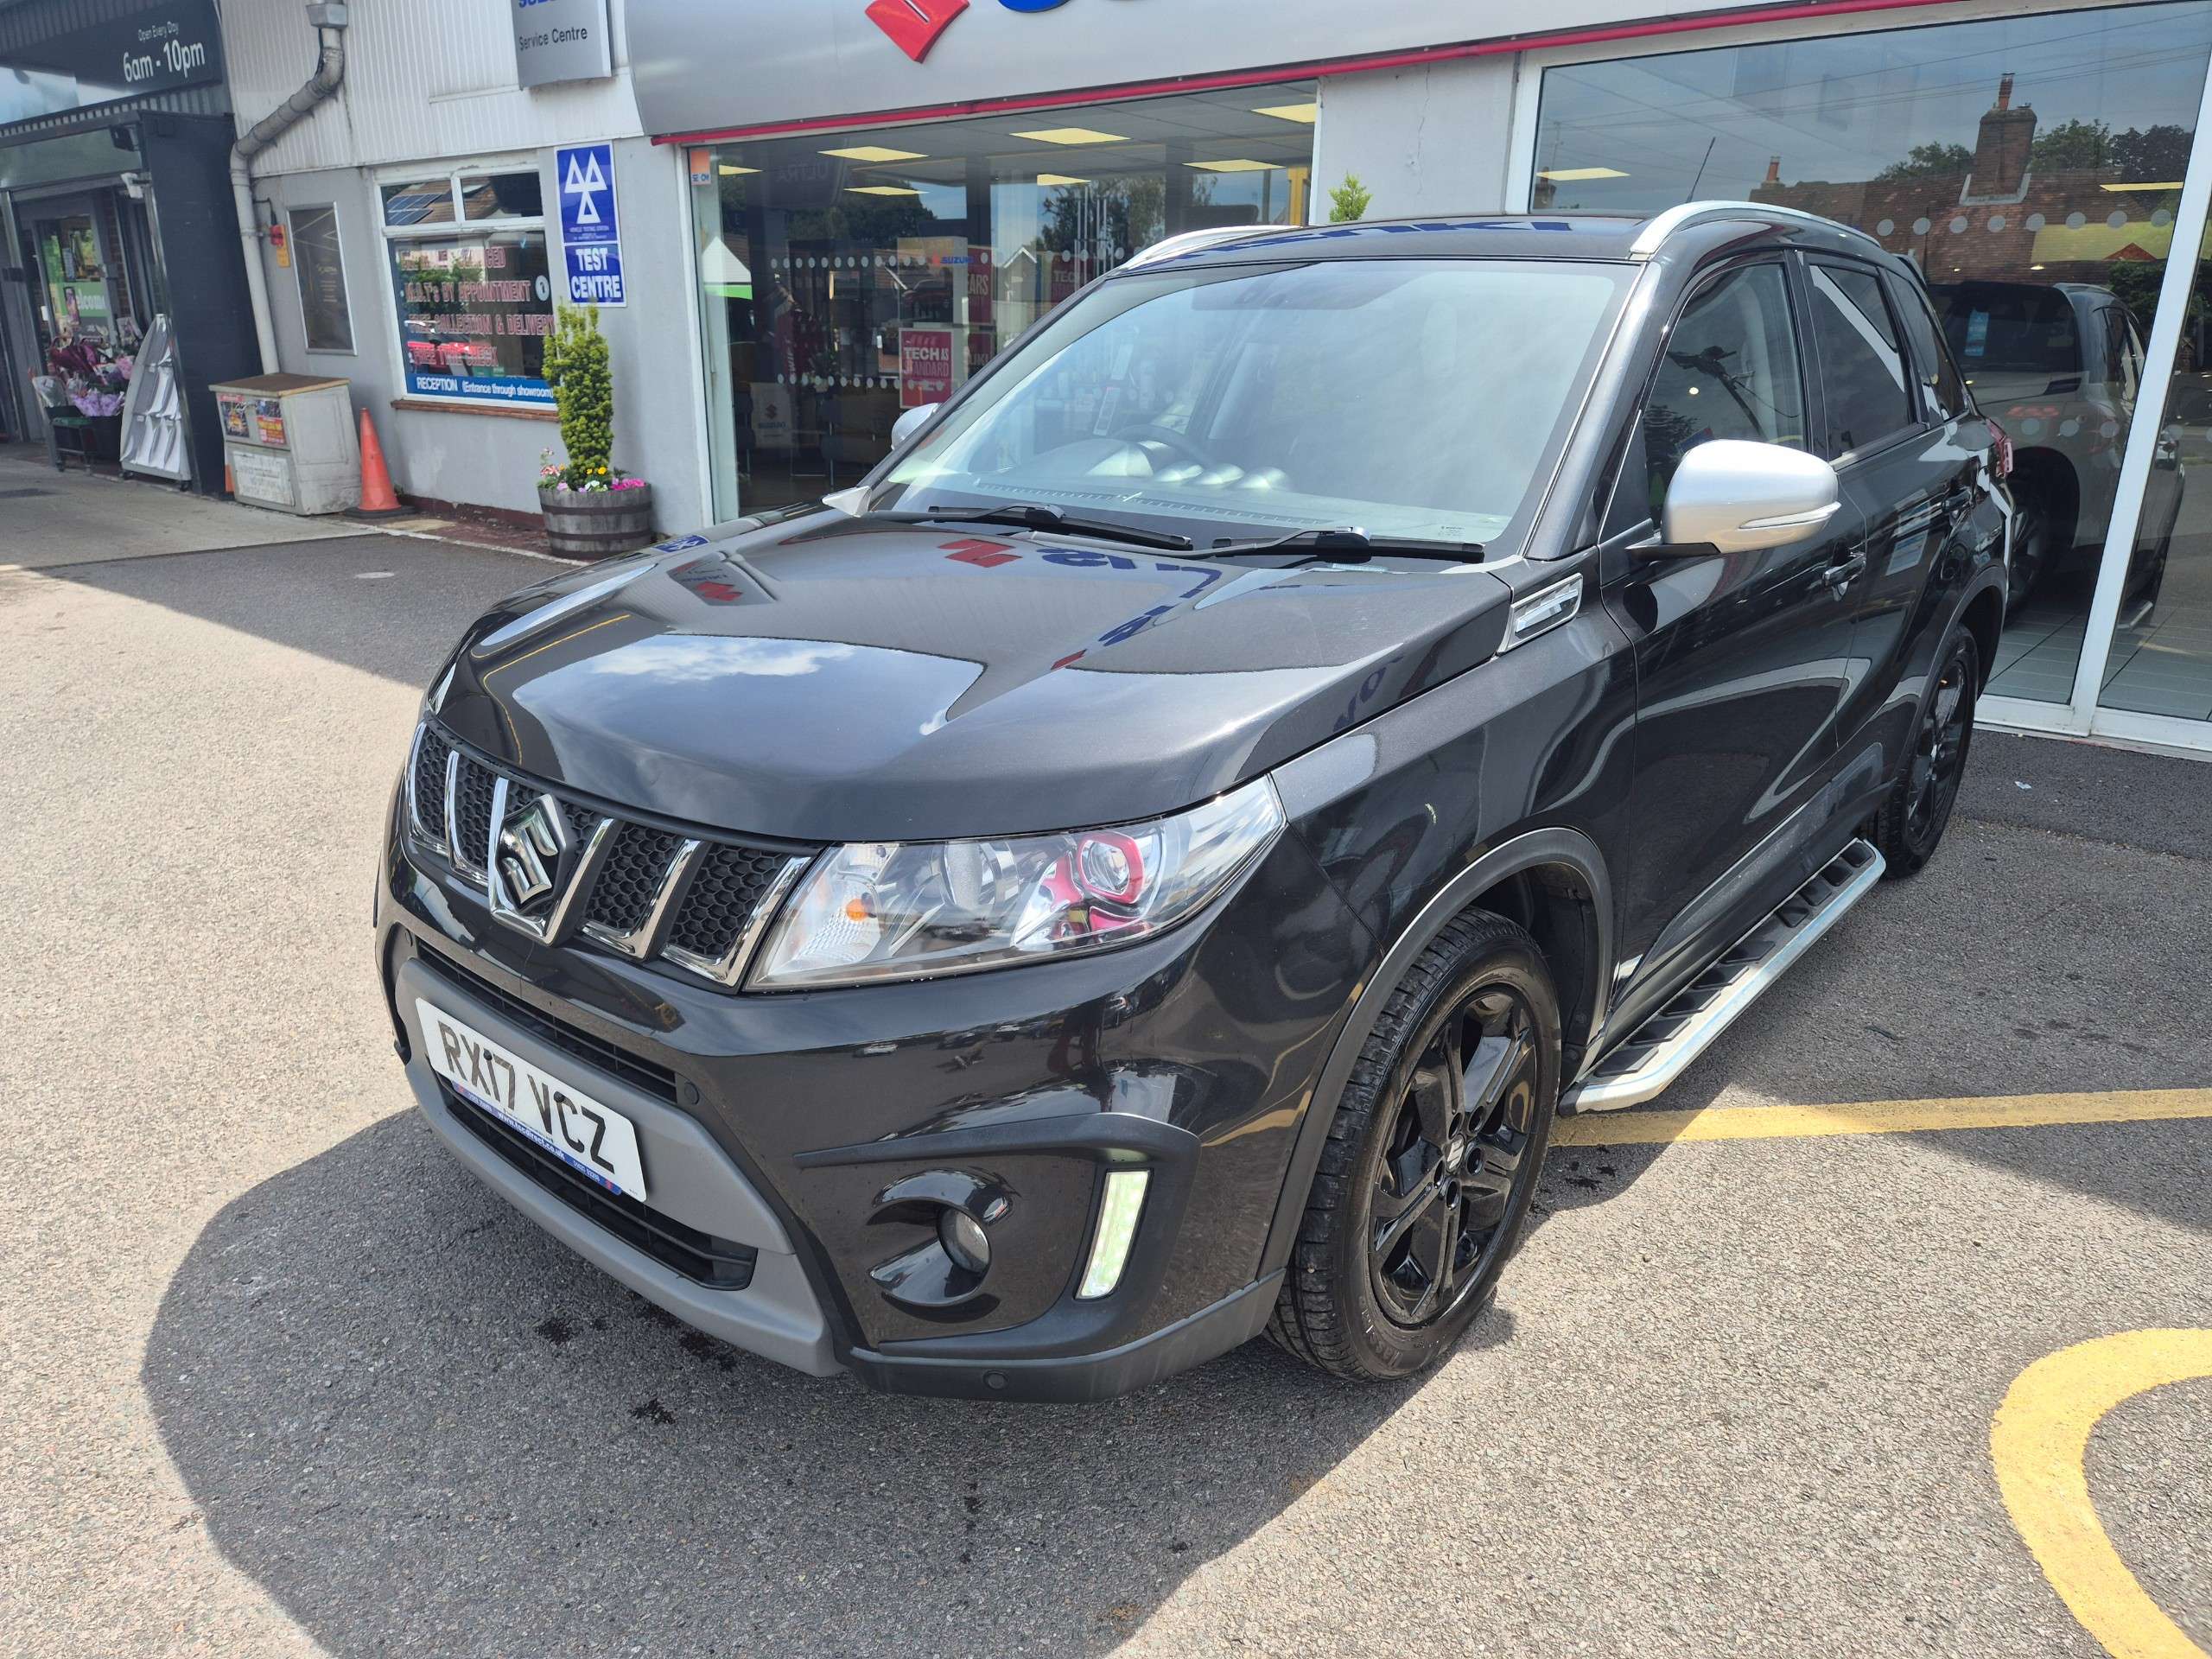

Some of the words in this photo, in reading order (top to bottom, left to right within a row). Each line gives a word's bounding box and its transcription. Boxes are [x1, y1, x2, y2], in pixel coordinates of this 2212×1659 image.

[518, 35, 549, 51] Service
[552, 27, 588, 43] Centre
[123, 51, 154, 82] 6am
[163, 39, 206, 79] 10pm
[575, 247, 608, 271] TEST
[442, 282, 454, 302] BY
[458, 280, 531, 302] APPOINTMENT
[571, 275, 622, 299] CENTRE
[435, 314, 493, 335] COLLECTION
[495, 315, 505, 335] &
[506, 315, 555, 336] DELIVERY
[903, 346, 939, 360] TECH
[904, 359, 949, 377] STANDARD
[416, 377, 459, 391] RECEPTION
[462, 380, 492, 394] (Entrance
[492, 381, 517, 397] through
[518, 385, 555, 398] showroom)
[437, 1020, 517, 1111] RX17
[526, 1073, 616, 1175] VCZ
